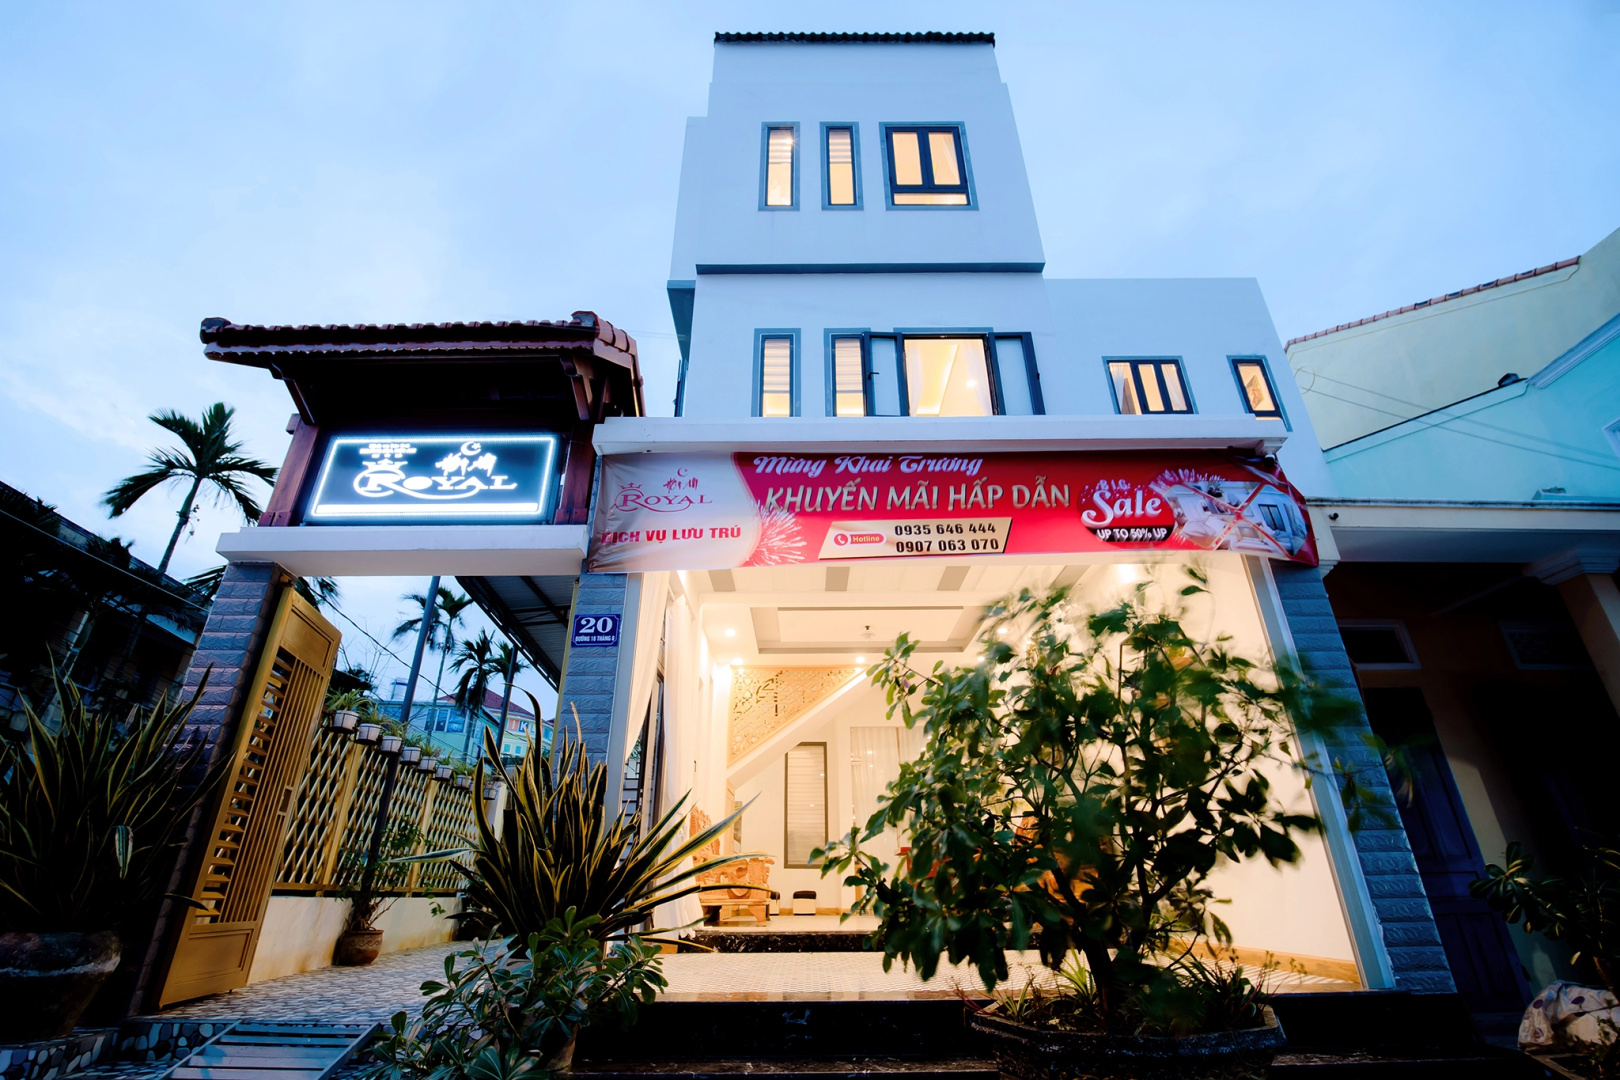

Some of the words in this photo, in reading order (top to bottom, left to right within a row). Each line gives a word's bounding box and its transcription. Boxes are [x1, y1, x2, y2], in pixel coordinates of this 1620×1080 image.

[753, 456, 827, 479] Mừng
[834, 455, 893, 475] Khai
[899, 455, 983, 477] Trương
[353, 468, 517, 500] ROYAL
[615, 488, 712, 513] ROYAL
[764, 477, 878, 514] KHUYẾN
[886, 480, 939, 511] MÃI
[948, 476, 1004, 511] HẤP
[1011, 475, 1070, 509] DẪN
[1080, 489, 1163, 528] Sale
[646, 530, 667, 543] VỤ
[672, 527, 704, 540] LƯU
[709, 525, 741, 539] TRÚ
[894, 524, 932, 536] 0935
[936, 523, 964, 535] 646
[968, 522, 996, 534] 444
[1096, 528, 1112, 540] UP
[1113, 528, 1129, 540] TO
[1130, 528, 1152, 540] 50%
[1153, 527, 1168, 539] UP
[852, 535, 880, 543] Hotline
[896, 540, 932, 553] 0907
[938, 539, 966, 552] 063
[971, 538, 999, 551] 070
[579, 617, 613, 633] 20
